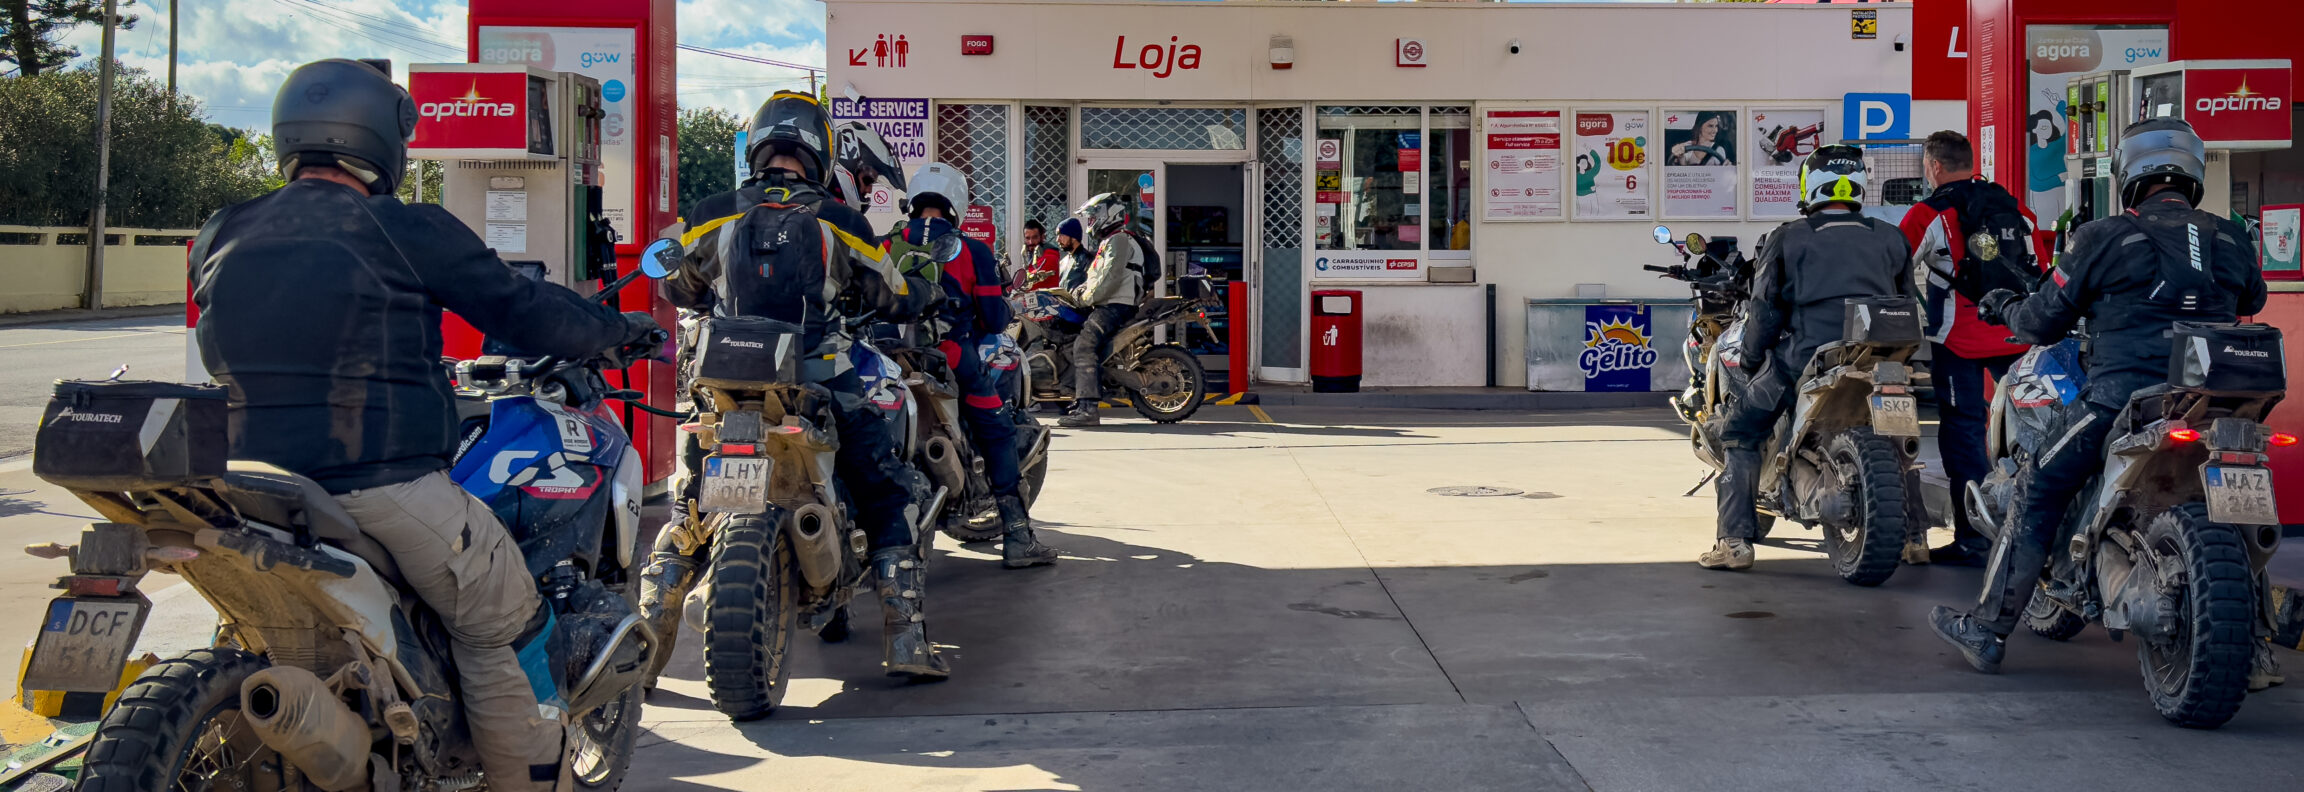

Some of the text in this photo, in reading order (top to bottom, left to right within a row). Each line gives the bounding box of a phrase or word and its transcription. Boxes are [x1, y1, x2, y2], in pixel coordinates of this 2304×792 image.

[484, 47, 542, 64] agora
[1113, 35, 1202, 78] Loja
[2037, 44, 2090, 61] agora
[420, 100, 515, 122] optima
[835, 102, 924, 117] SELF SERVICE
[2195, 95, 2282, 117] optima
[1580, 120, 1608, 130] agora
[1859, 101, 1894, 148] P
[1626, 174, 1637, 190] 6
[2187, 222, 2203, 272] USWE
[730, 340, 764, 349] TOURATECH
[1578, 344, 1658, 378] Gelito
[2234, 350, 2269, 358] TOURATECH
[1884, 400, 1910, 413] SKP
[71, 412, 122, 424] TOURATECH
[724, 462, 764, 480] LHY
[538, 485, 578, 494] TROPHY
[2223, 472, 2266, 492] WAZ
[627, 498, 641, 517] GS
[68, 609, 129, 637] DCF
